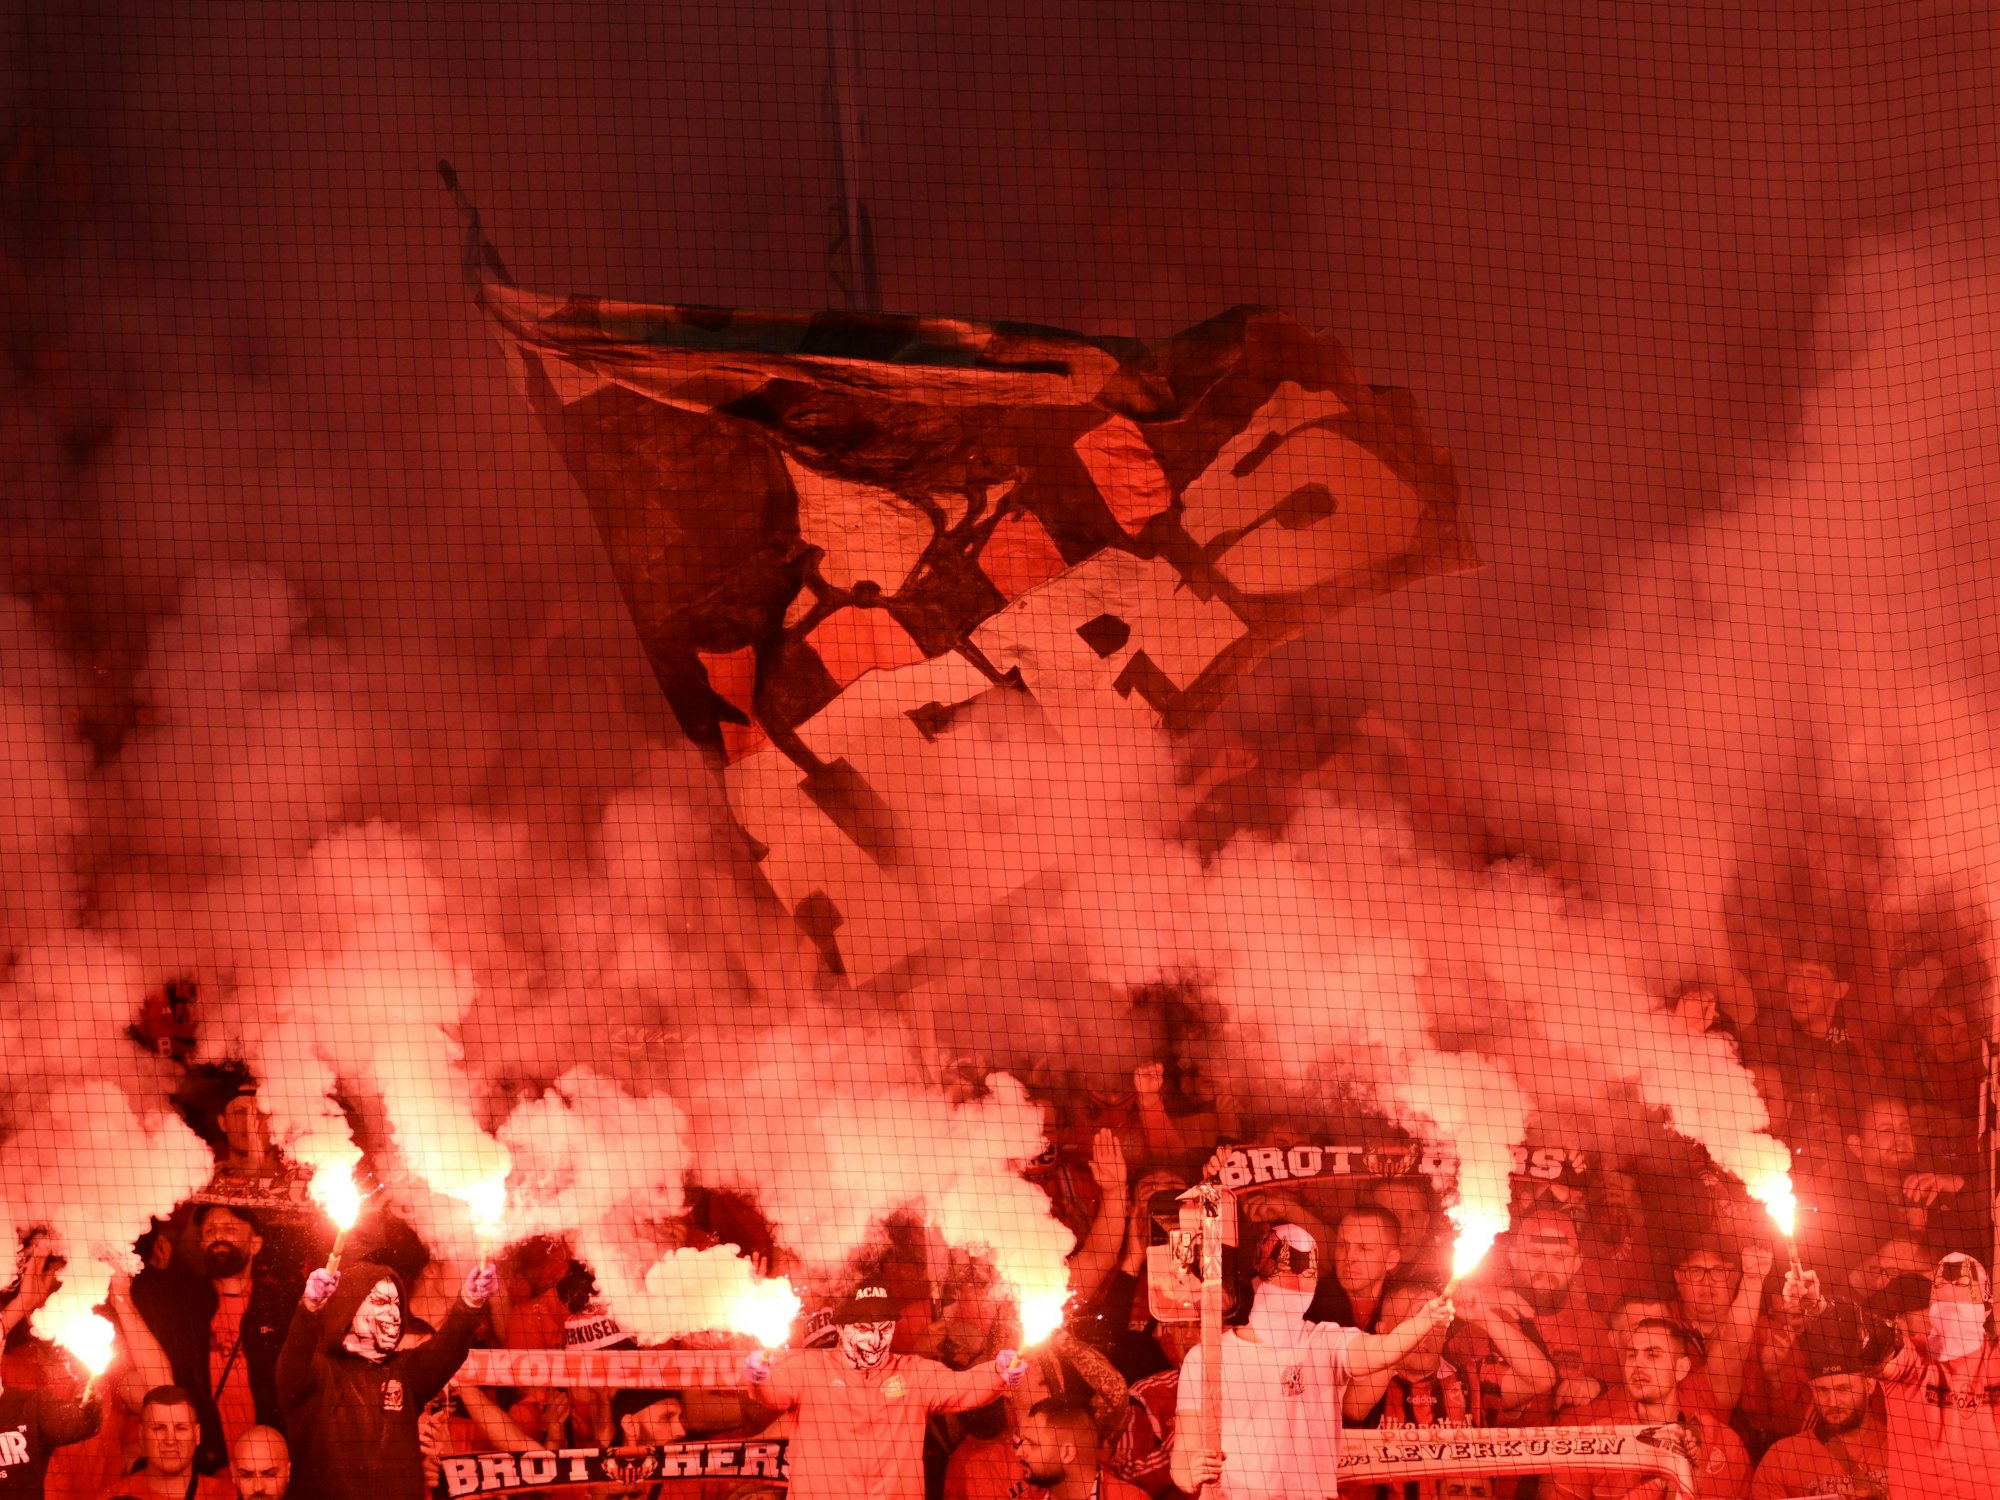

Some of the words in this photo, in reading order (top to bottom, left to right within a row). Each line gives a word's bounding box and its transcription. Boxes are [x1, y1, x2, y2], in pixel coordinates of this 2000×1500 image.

[1218, 1146, 1363, 1188] BROT
[1418, 1146, 1566, 1180] HS
[855, 1286, 887, 1300] ACAB
[484, 1354, 747, 1388] KOLLEKTIV
[1406, 1395, 1438, 1404] adidas
[1957, 1397, 1978, 1408] 04
[1373, 1437, 1626, 1463] LEVERKUSEN
[442, 1447, 600, 1498] BROT
